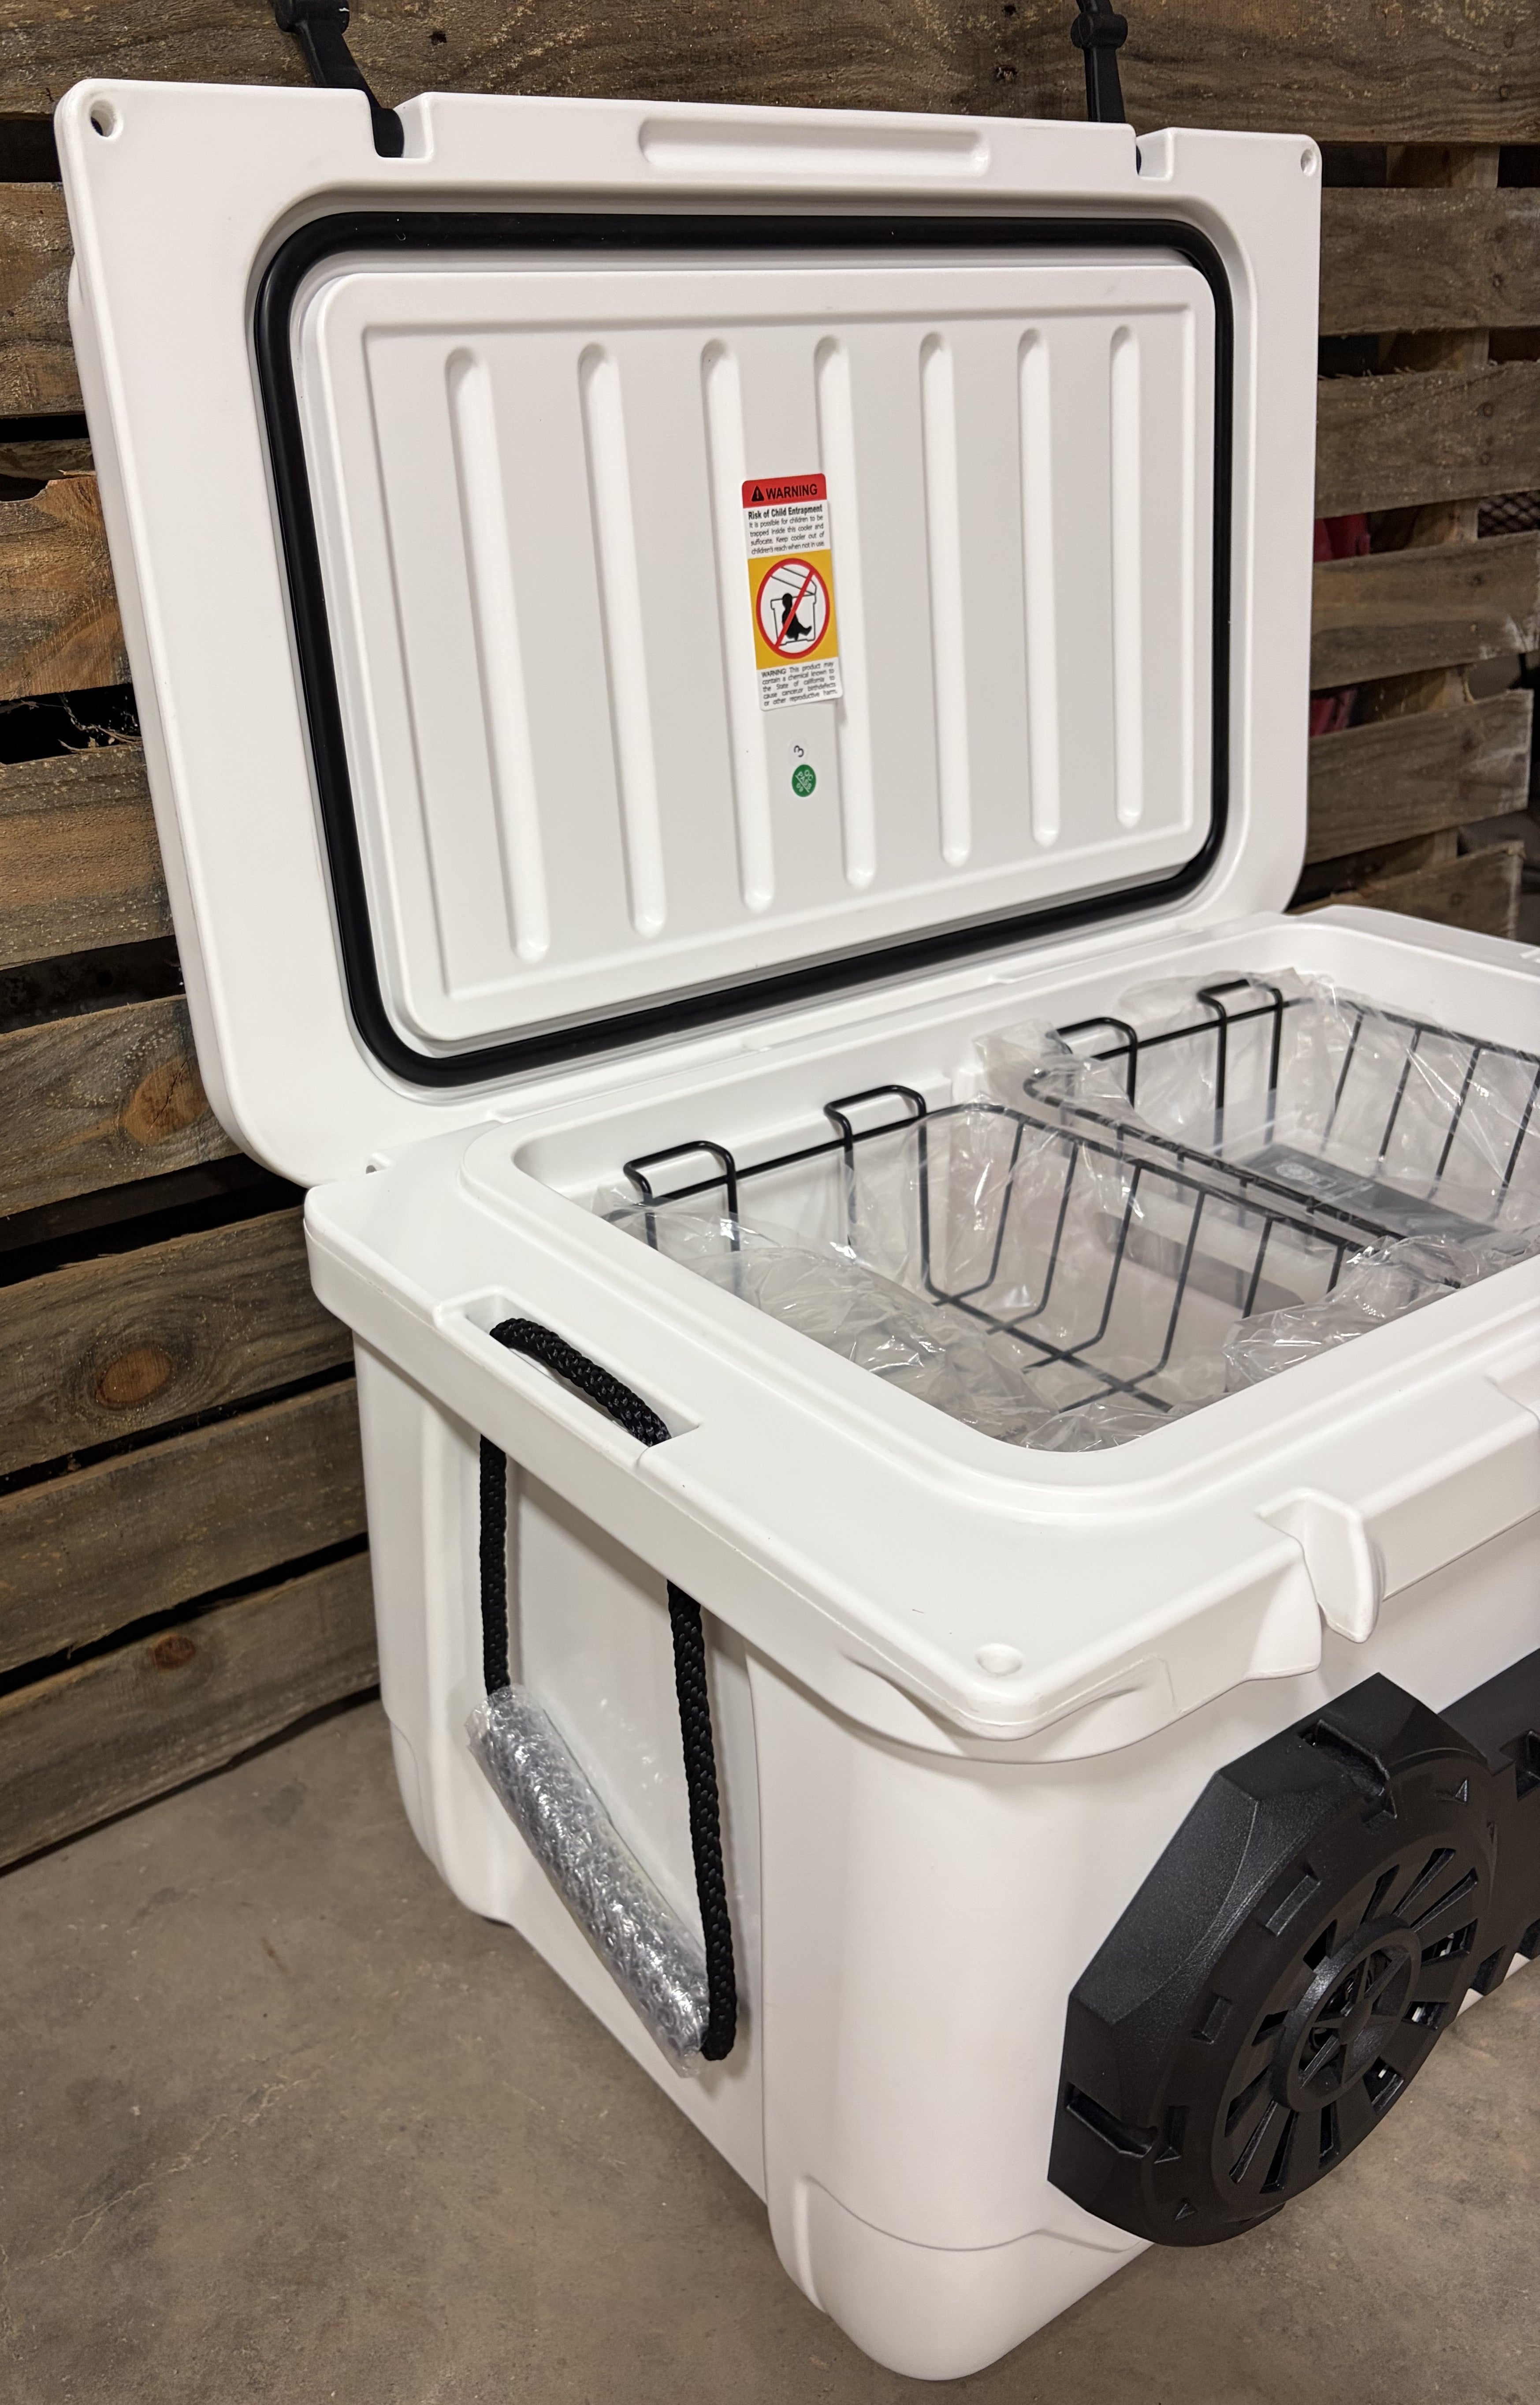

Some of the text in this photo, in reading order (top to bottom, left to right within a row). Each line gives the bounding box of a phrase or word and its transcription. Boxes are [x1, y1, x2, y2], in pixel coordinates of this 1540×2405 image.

[766, 484, 818, 500] WARNING
[748, 504, 822, 520] Risk of Child Entrapment
[760, 519, 780, 528] possible
[750, 529, 769, 537] trapped
[802, 663, 821, 671] product
[788, 671, 808, 681] chemical
[789, 692, 820, 702] reproductive
